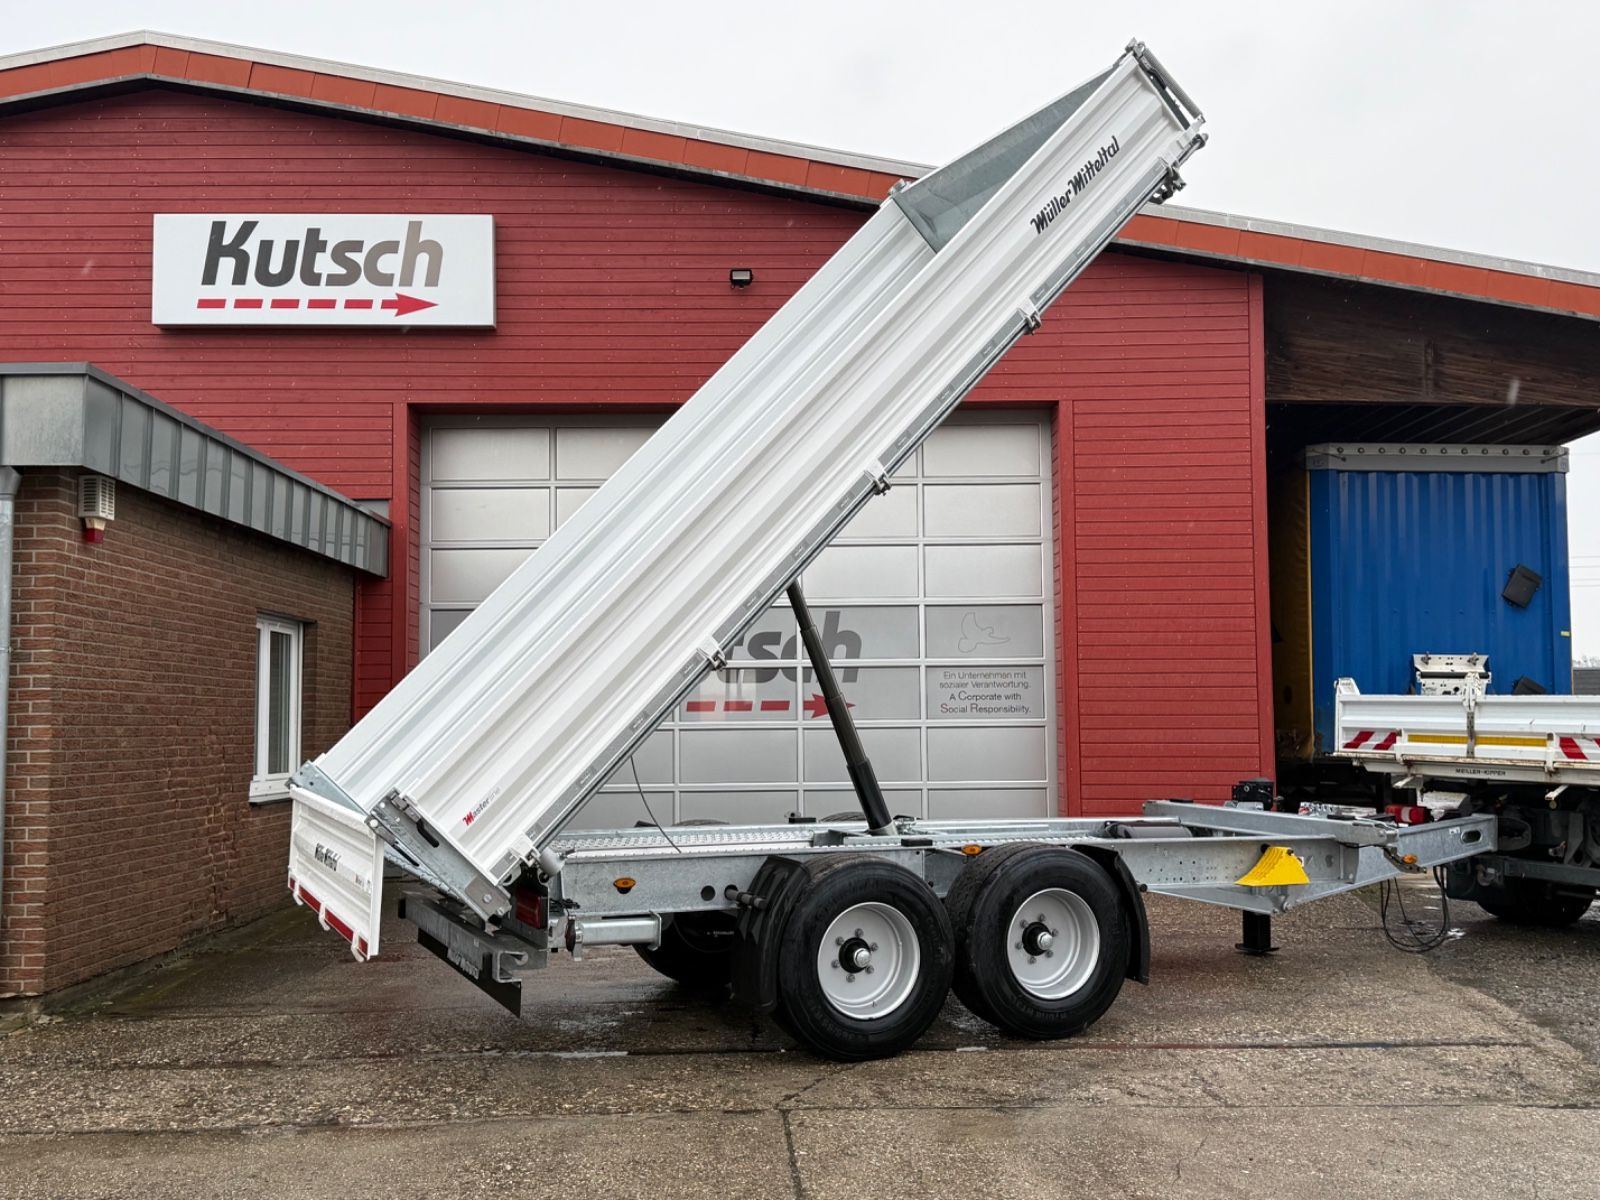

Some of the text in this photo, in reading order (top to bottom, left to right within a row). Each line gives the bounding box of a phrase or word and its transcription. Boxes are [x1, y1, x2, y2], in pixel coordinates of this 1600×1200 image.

[1030, 135, 1120, 234] Müller Mitteltal
[201, 220, 444, 287] Kutsch
[943, 671, 1027, 680] Ein Unternehmen mit
[939, 681, 969, 689] sozialer
[949, 690, 1022, 702] A Corporate with
[940, 703, 968, 714] Social
